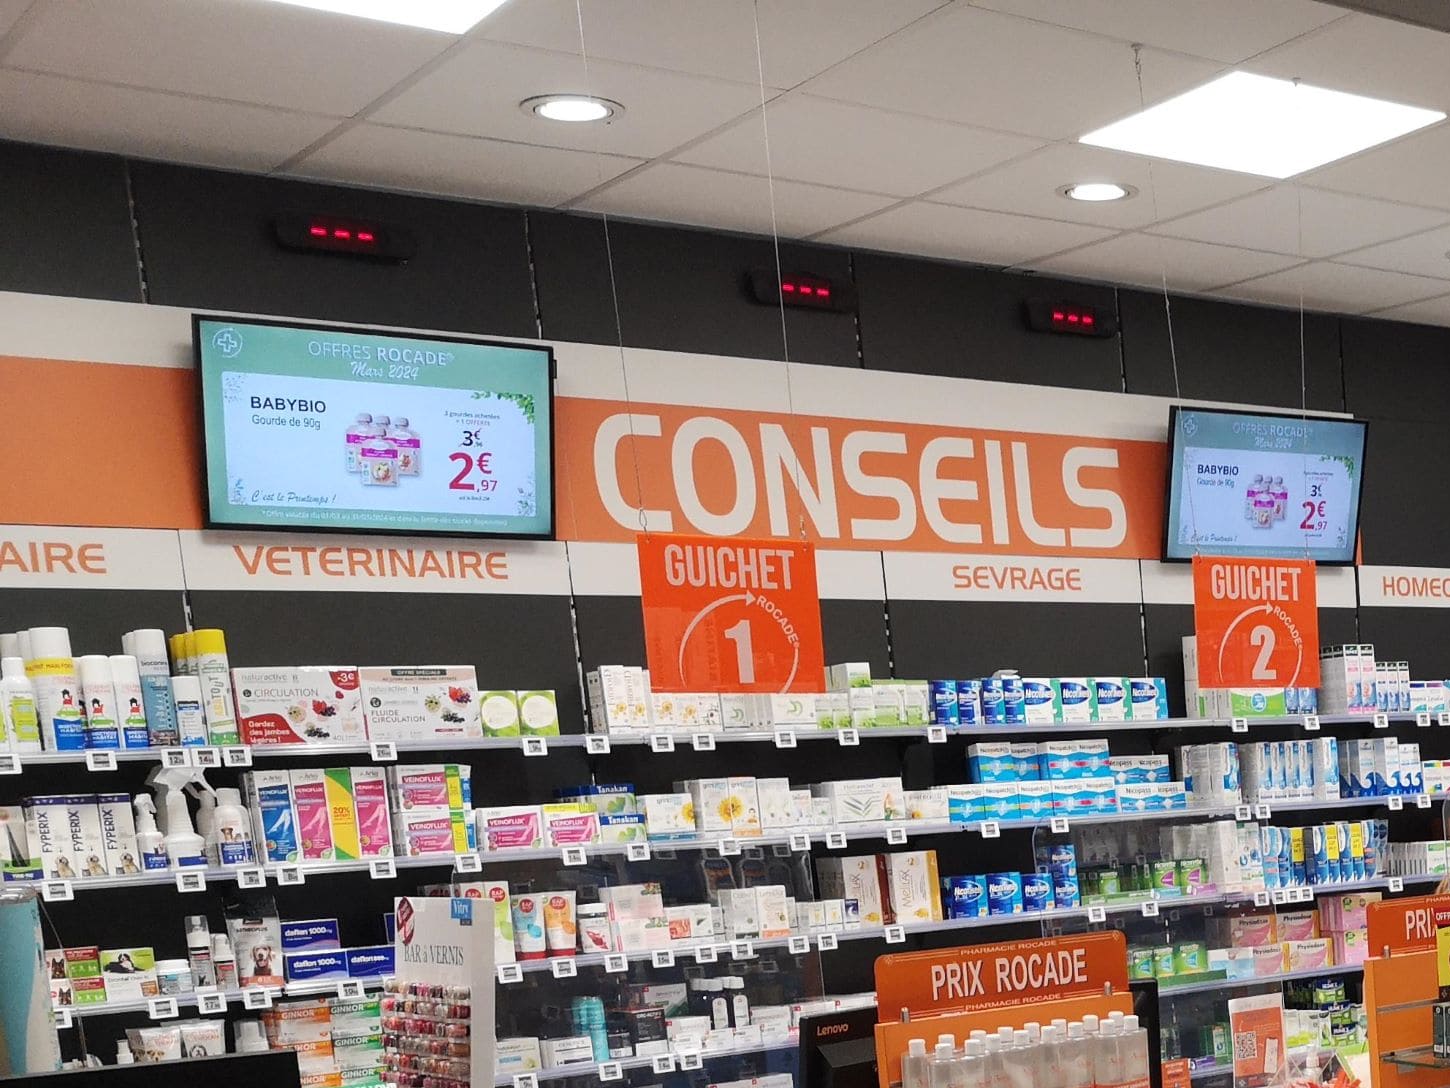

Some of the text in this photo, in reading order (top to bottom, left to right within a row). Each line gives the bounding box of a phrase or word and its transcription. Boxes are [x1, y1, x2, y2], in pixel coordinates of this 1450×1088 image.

[308, 341, 371, 360] OFFRES
[350, 360, 419, 380] Mars 2024
[250, 396, 326, 413] BABYBIO
[252, 414, 321, 431] Gourde de 90g
[1197, 464, 1239, 476] BABYBIO
[593, 412, 1128, 549] CONSEILS
[0, 543, 108, 575] AIRE
[233, 546, 510, 579] VETERINAIRE
[664, 544, 795, 590] GUICHET
[952, 565, 1082, 591] SEVRAGE
[1210, 563, 1302, 601] GUICHET
[724, 619, 755, 684] 1
[1250, 625, 1276, 681] 2
[254, 688, 320, 698] CIRCULATION
[372, 716, 427, 724] CIRCULATION
[404, 775, 444, 784] VEINOFLUX
[597, 785, 628, 793] Tanakan
[410, 821, 449, 830] VEINOFLUX
[489, 818, 525, 826] VEINOFLUX
[550, 819, 585, 827] VEINOFLUX
[608, 815, 638, 824] Tanakan
[37, 811, 53, 853] FYPERIX
[68, 809, 84, 852] FYPERIX
[101, 808, 118, 850] FYPERIX
[453, 900, 470, 914] Vitry
[285, 928, 308, 937] daflon
[404, 946, 464, 966] BAR VERNIS
[961, 940, 1057, 956] PHARMACIE ROCADE
[294, 960, 316, 968] daflon
[351, 955, 373, 963] daflon
[931, 948, 1088, 1001] PRIX ROCADE
[331, 1003, 364, 1014] GINKOR
[965, 993, 1060, 1011] PHARMACIE ROCADE
[281, 1009, 315, 1019] GINKOR
[816, 1022, 849, 1036] Lenovo
[335, 1035, 369, 1047] GINKOR
[341, 1067, 375, 1079] GINKOR
